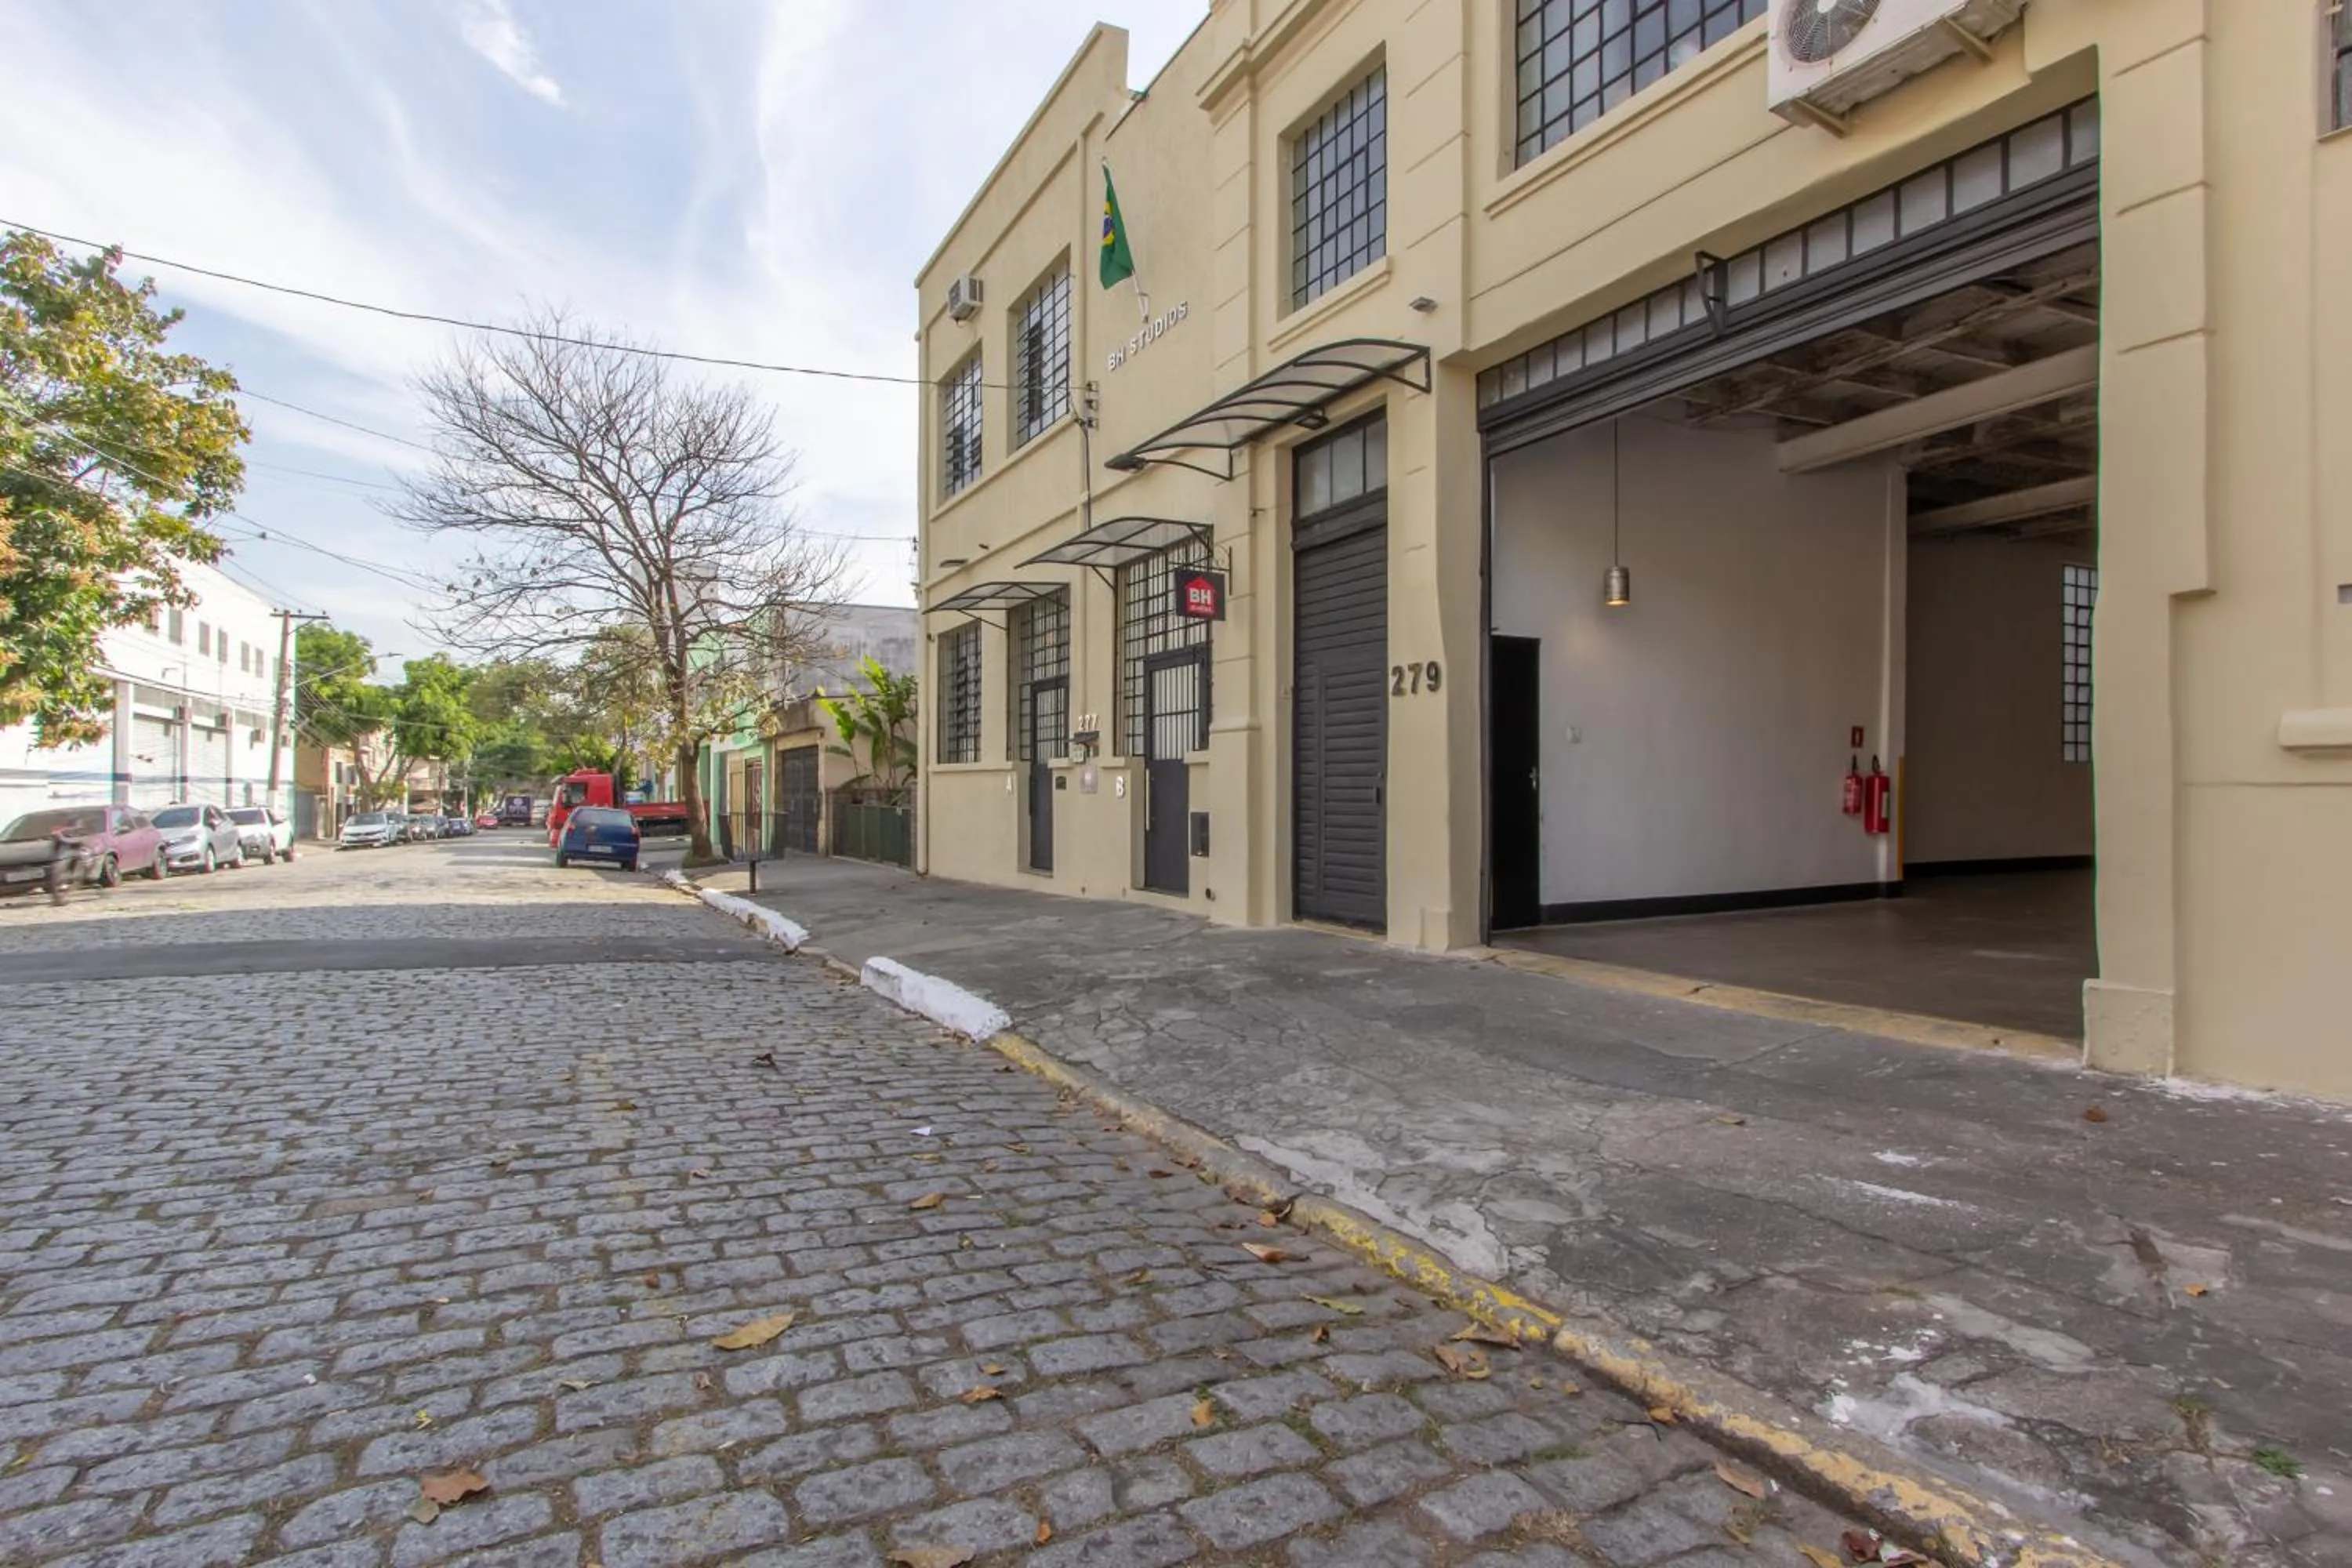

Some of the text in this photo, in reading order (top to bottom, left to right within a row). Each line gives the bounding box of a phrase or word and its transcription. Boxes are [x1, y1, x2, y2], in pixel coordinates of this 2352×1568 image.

[1109, 301, 1188, 371] BH STUDIOS
[1189, 587, 1211, 604] BH
[1391, 661, 1442, 696] 279
[1078, 714, 1099, 731] 277
[1116, 775, 1124, 798] B
